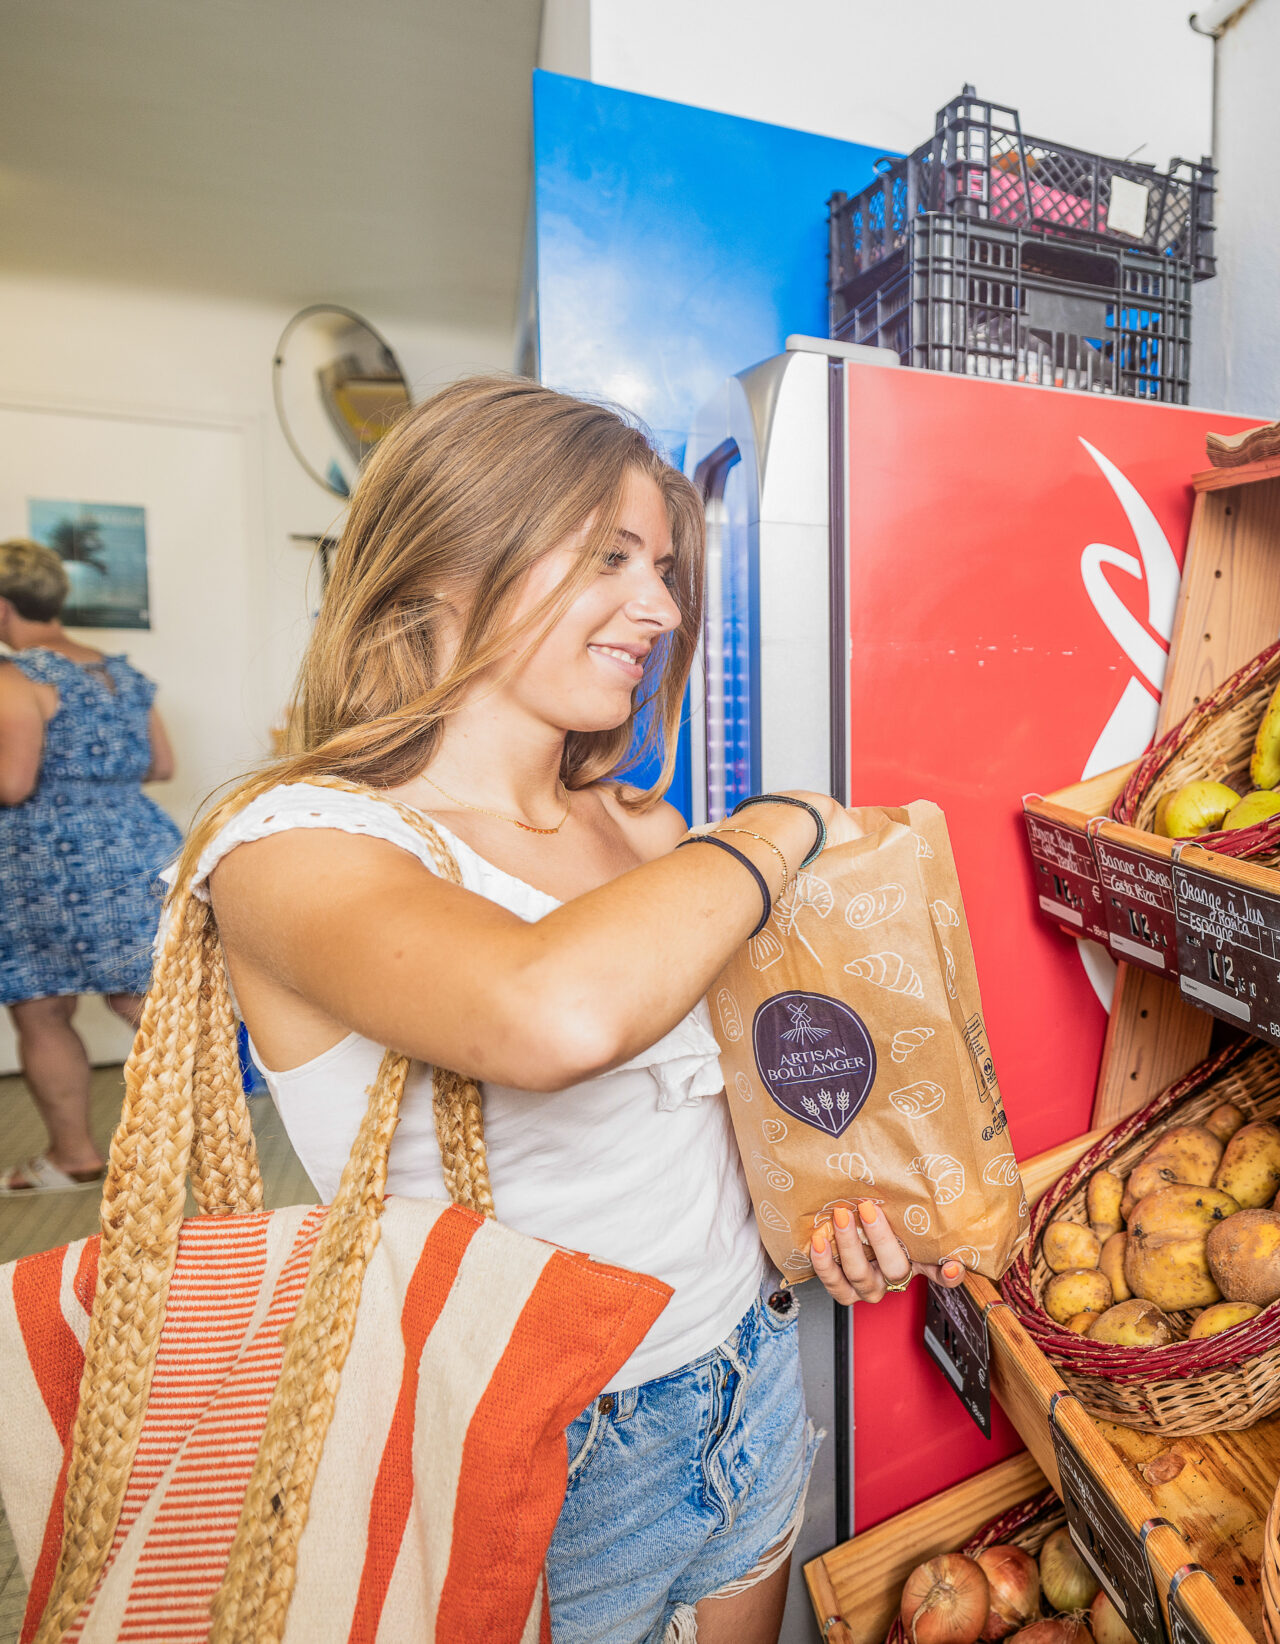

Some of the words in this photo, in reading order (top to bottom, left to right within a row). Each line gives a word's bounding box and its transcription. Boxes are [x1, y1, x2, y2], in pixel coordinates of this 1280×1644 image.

[1099, 848, 1139, 878] Banane
[1110, 874, 1134, 896] Costa
[1180, 879, 1223, 922] Orange
[1190, 912, 1236, 950] Espagne
[767, 1056, 866, 1081] BOULANGER
[781, 1046, 848, 1067] ARTISAN
